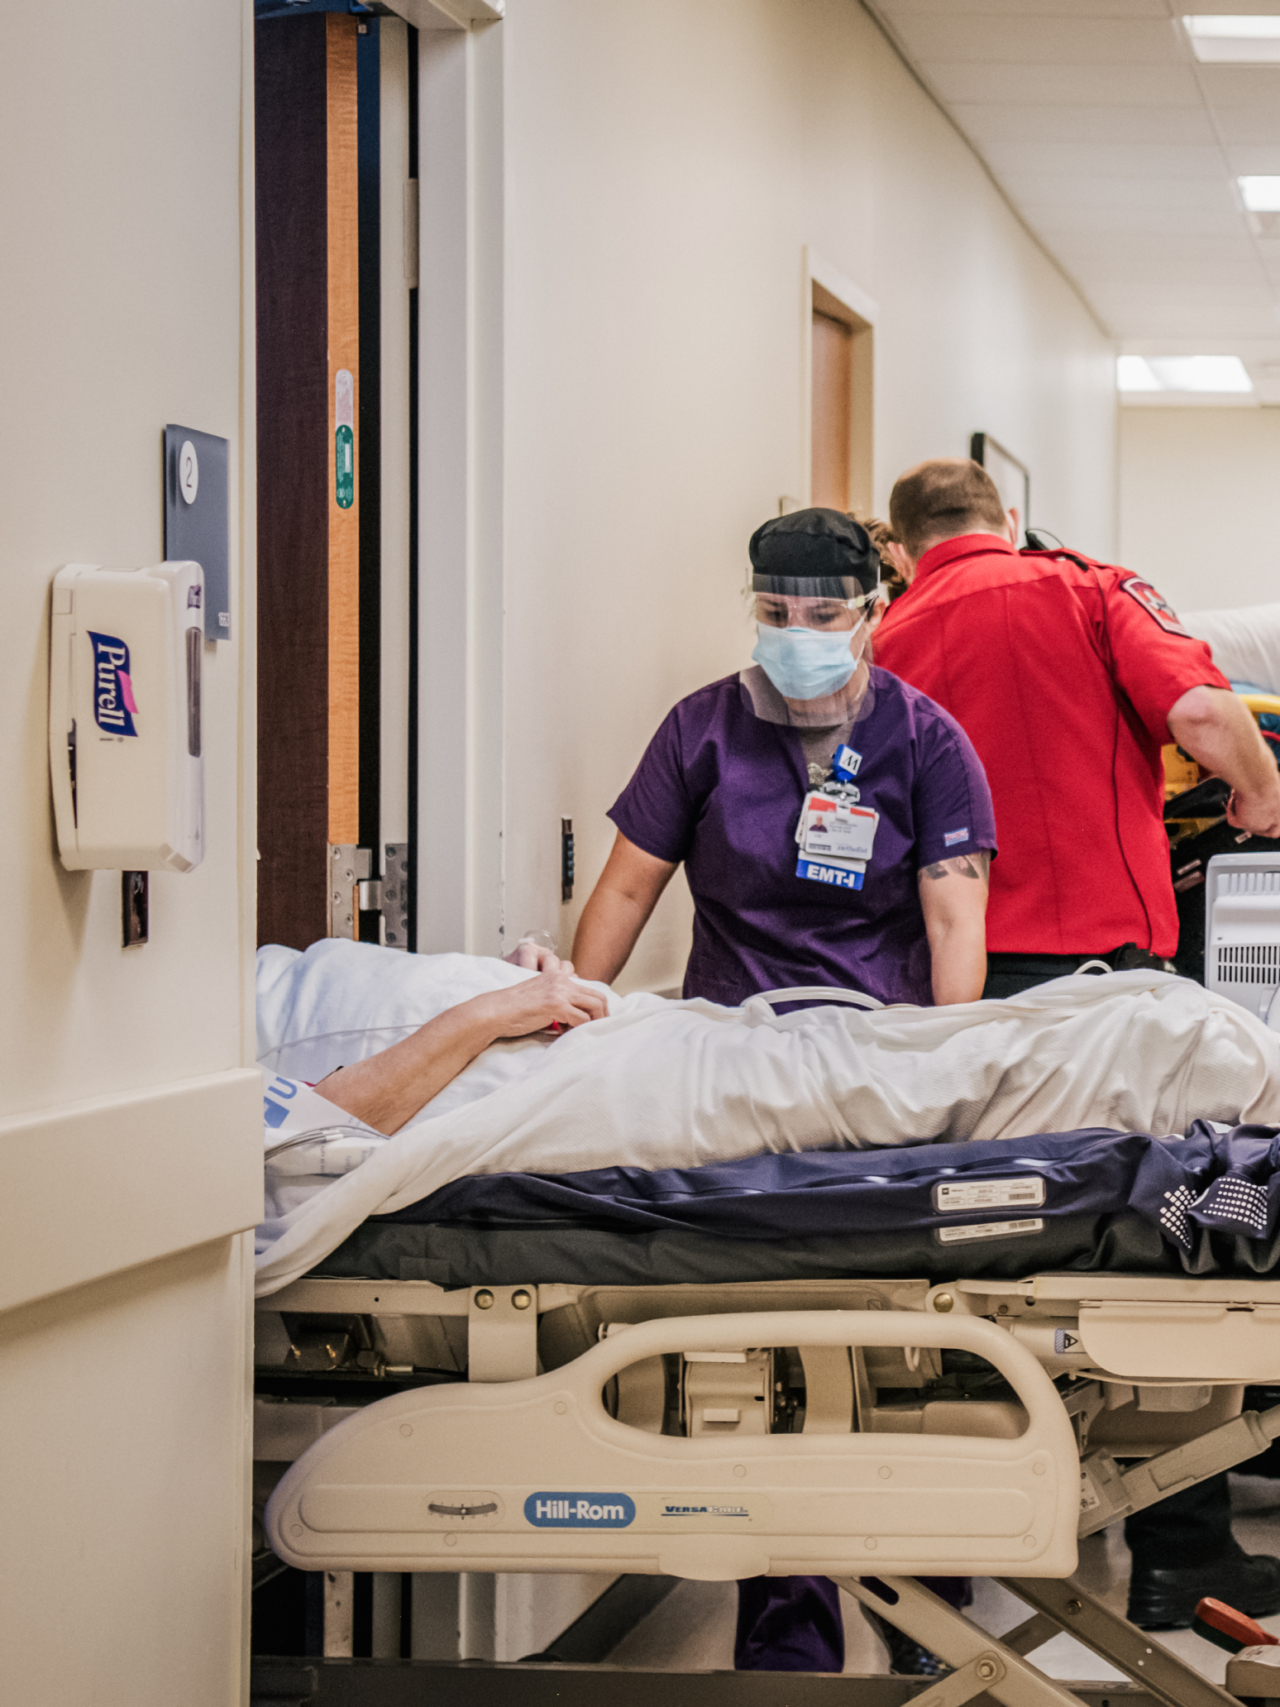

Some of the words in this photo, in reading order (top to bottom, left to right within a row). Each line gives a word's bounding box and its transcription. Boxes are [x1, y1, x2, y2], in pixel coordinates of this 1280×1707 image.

[185, 455, 193, 489] 2
[97, 642, 126, 726] Purell
[806, 864, 856, 888] EMT-I
[535, 1499, 625, 1520] Hill-Rom
